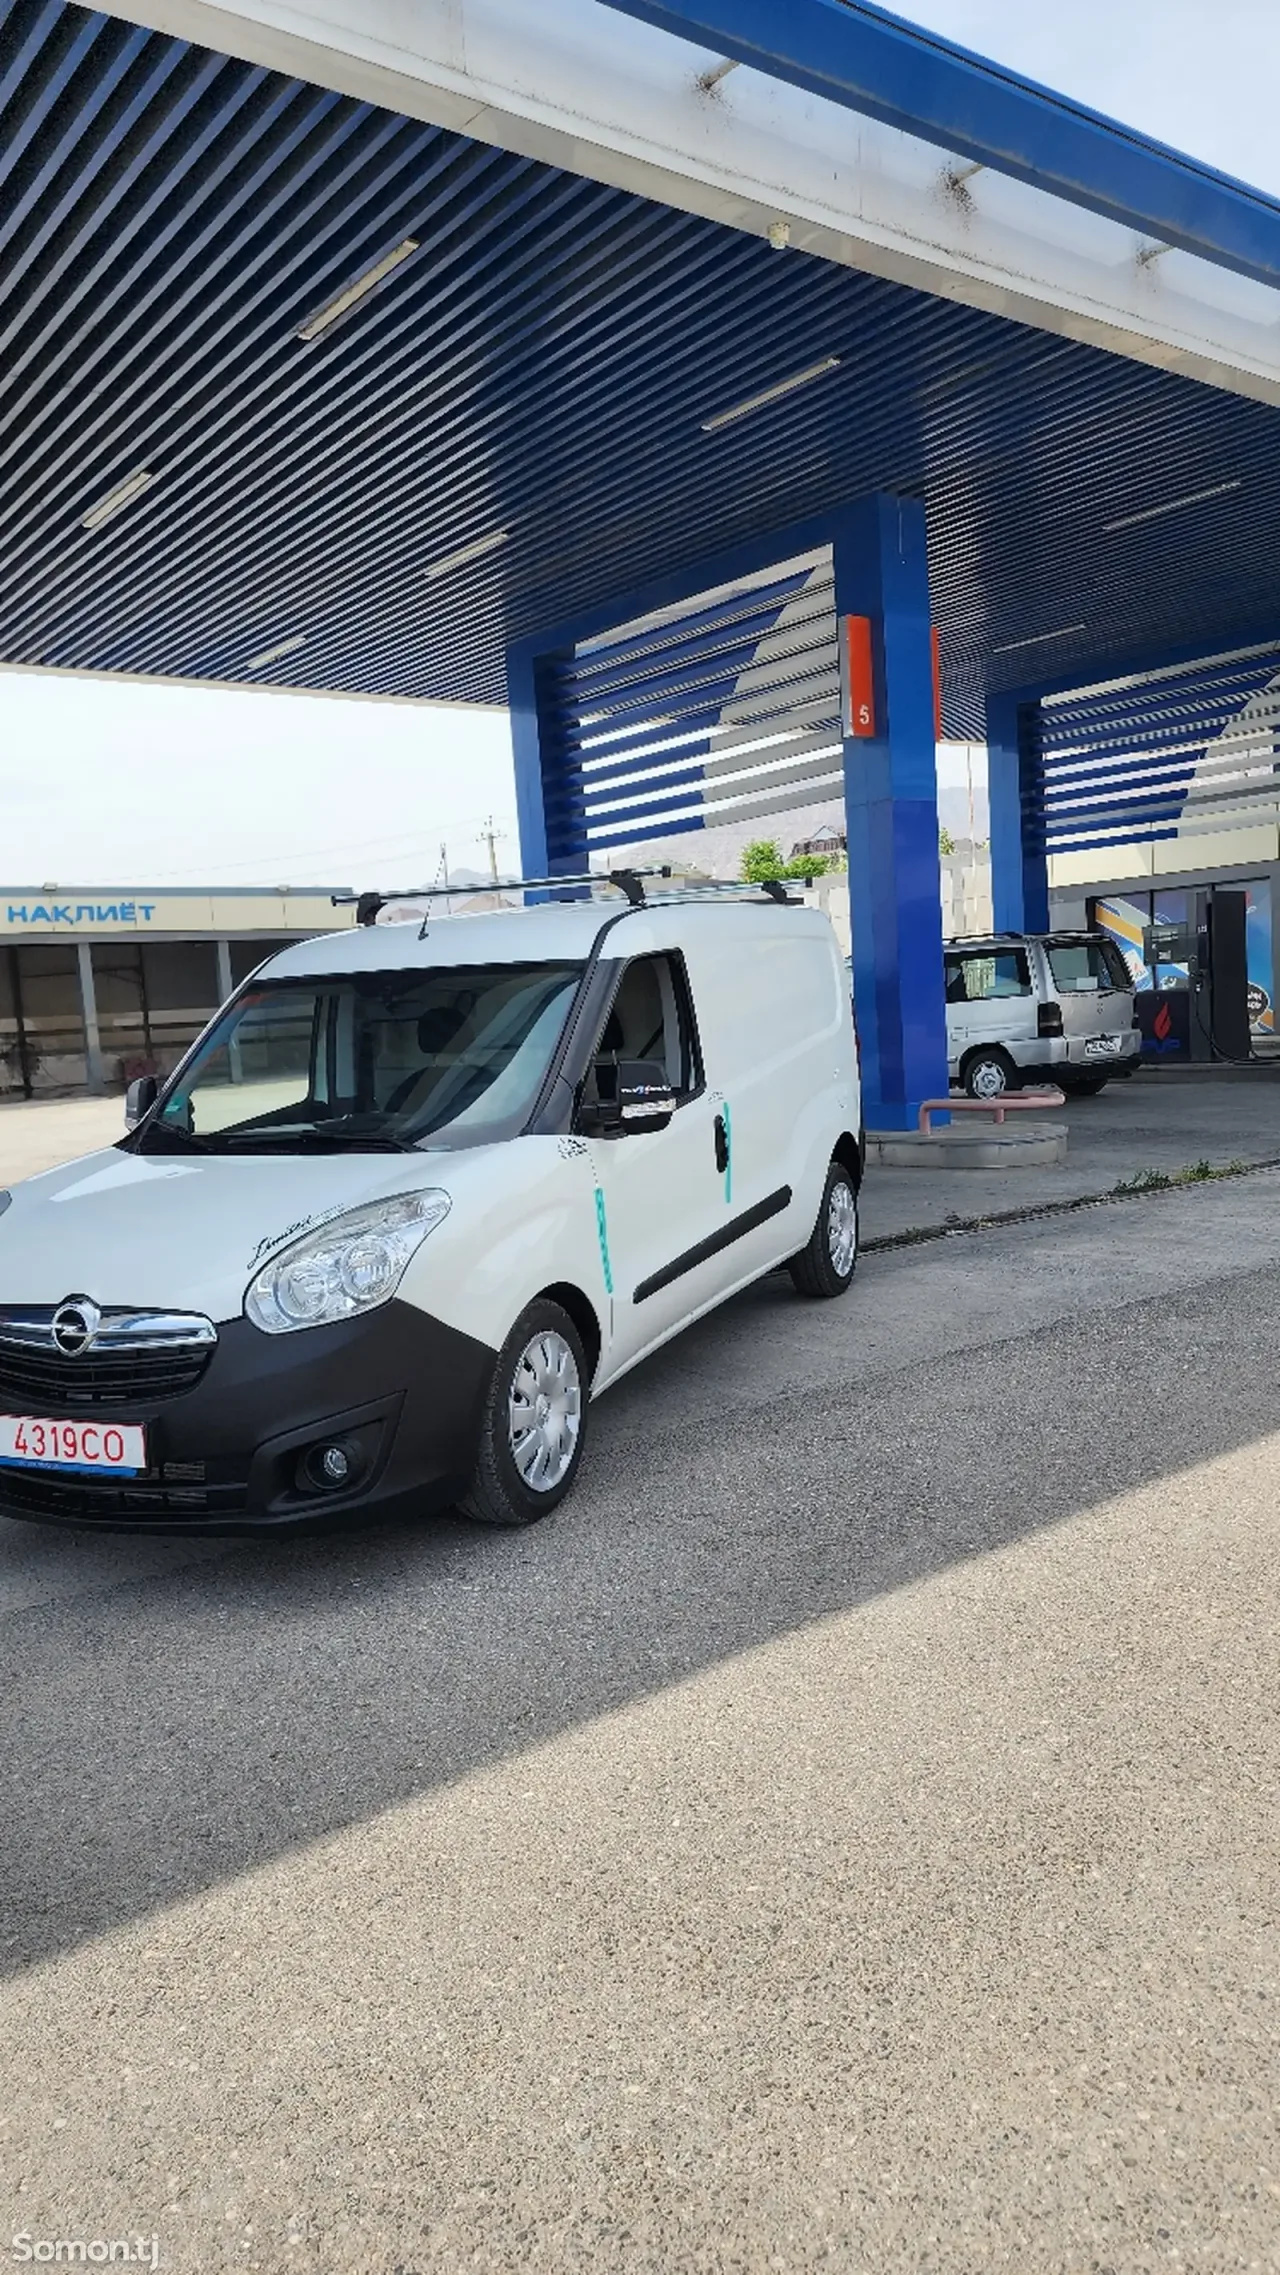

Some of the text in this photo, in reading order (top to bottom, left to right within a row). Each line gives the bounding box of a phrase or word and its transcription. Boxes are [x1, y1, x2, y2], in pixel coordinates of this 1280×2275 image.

[859, 704, 870, 725] 5
[7, 902, 156, 925] НАҚЛИЁТ
[15, 1423, 124, 1462] 4319CO
